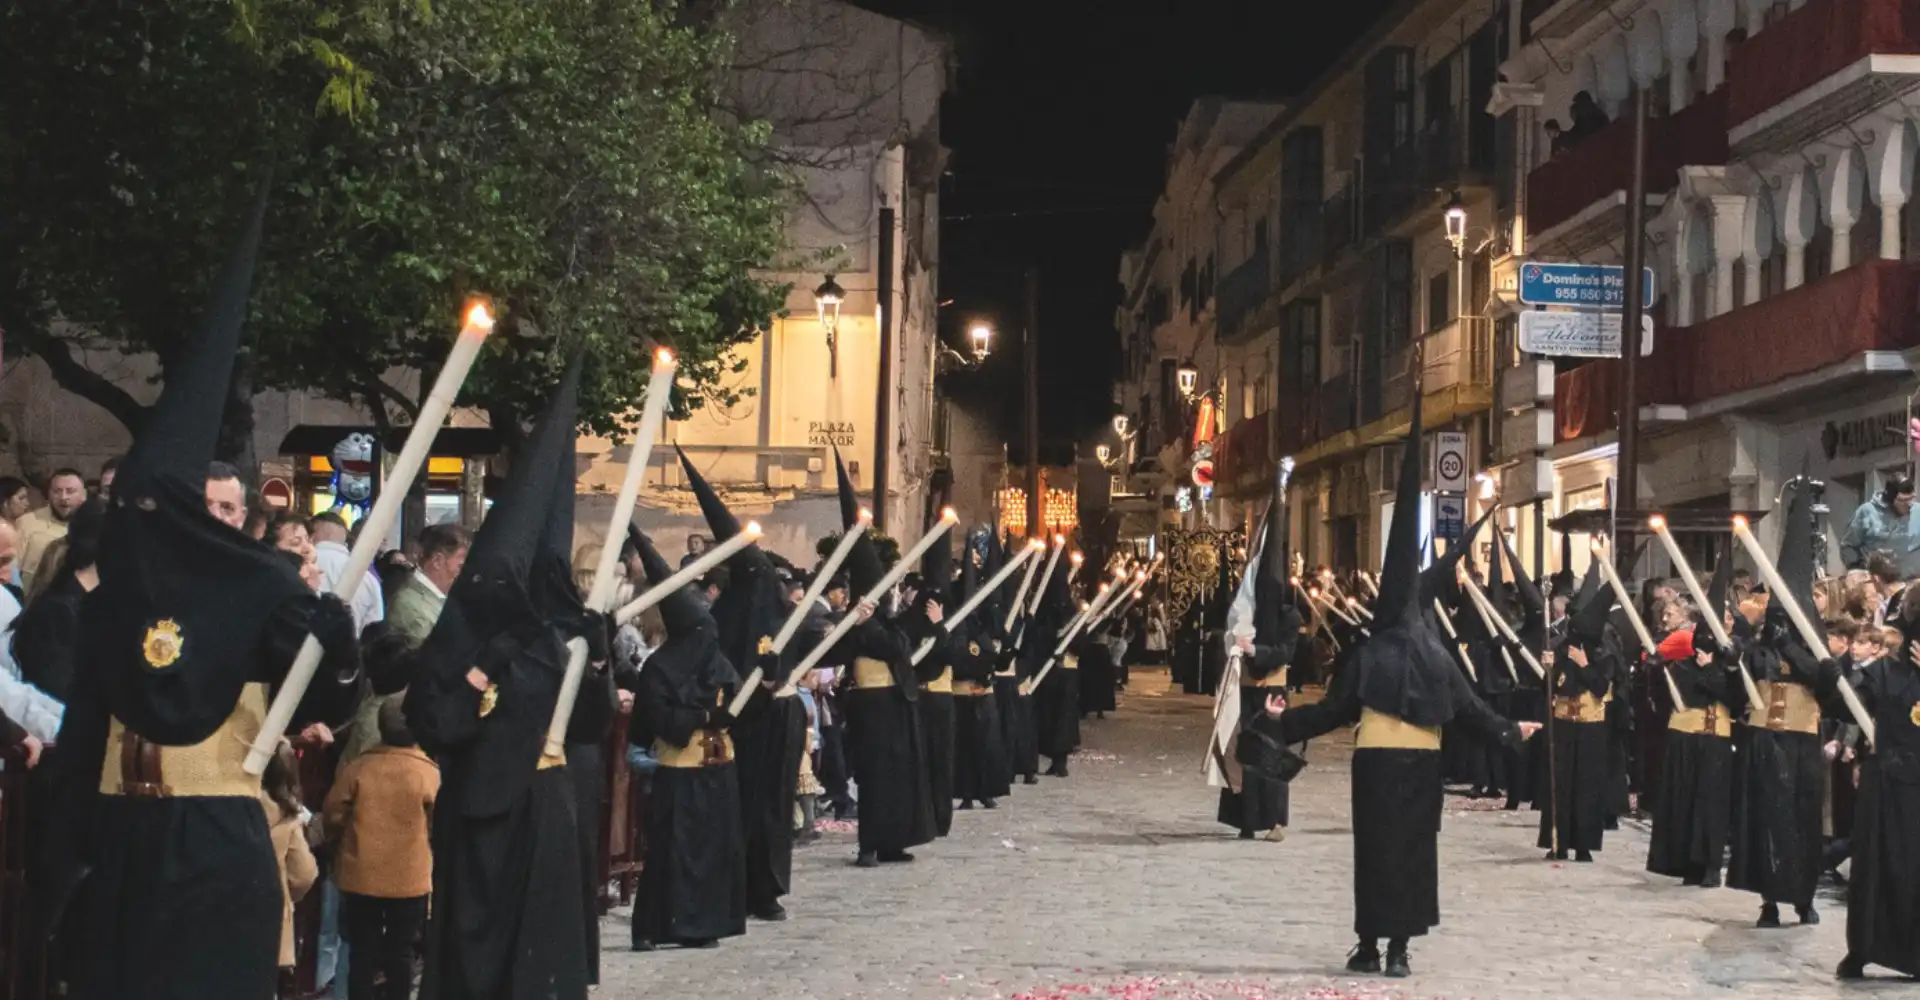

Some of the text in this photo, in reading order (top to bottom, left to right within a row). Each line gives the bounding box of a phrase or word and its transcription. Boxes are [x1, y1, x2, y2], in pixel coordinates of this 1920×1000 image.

[1543, 273, 1623, 287] Domino's Piz
[1555, 287, 1578, 299] 955
[809, 421, 855, 432] PLAZA
[808, 435, 855, 446] MAYOR
[1442, 435, 1461, 443] ZONA
[1443, 460, 1459, 471] 20
